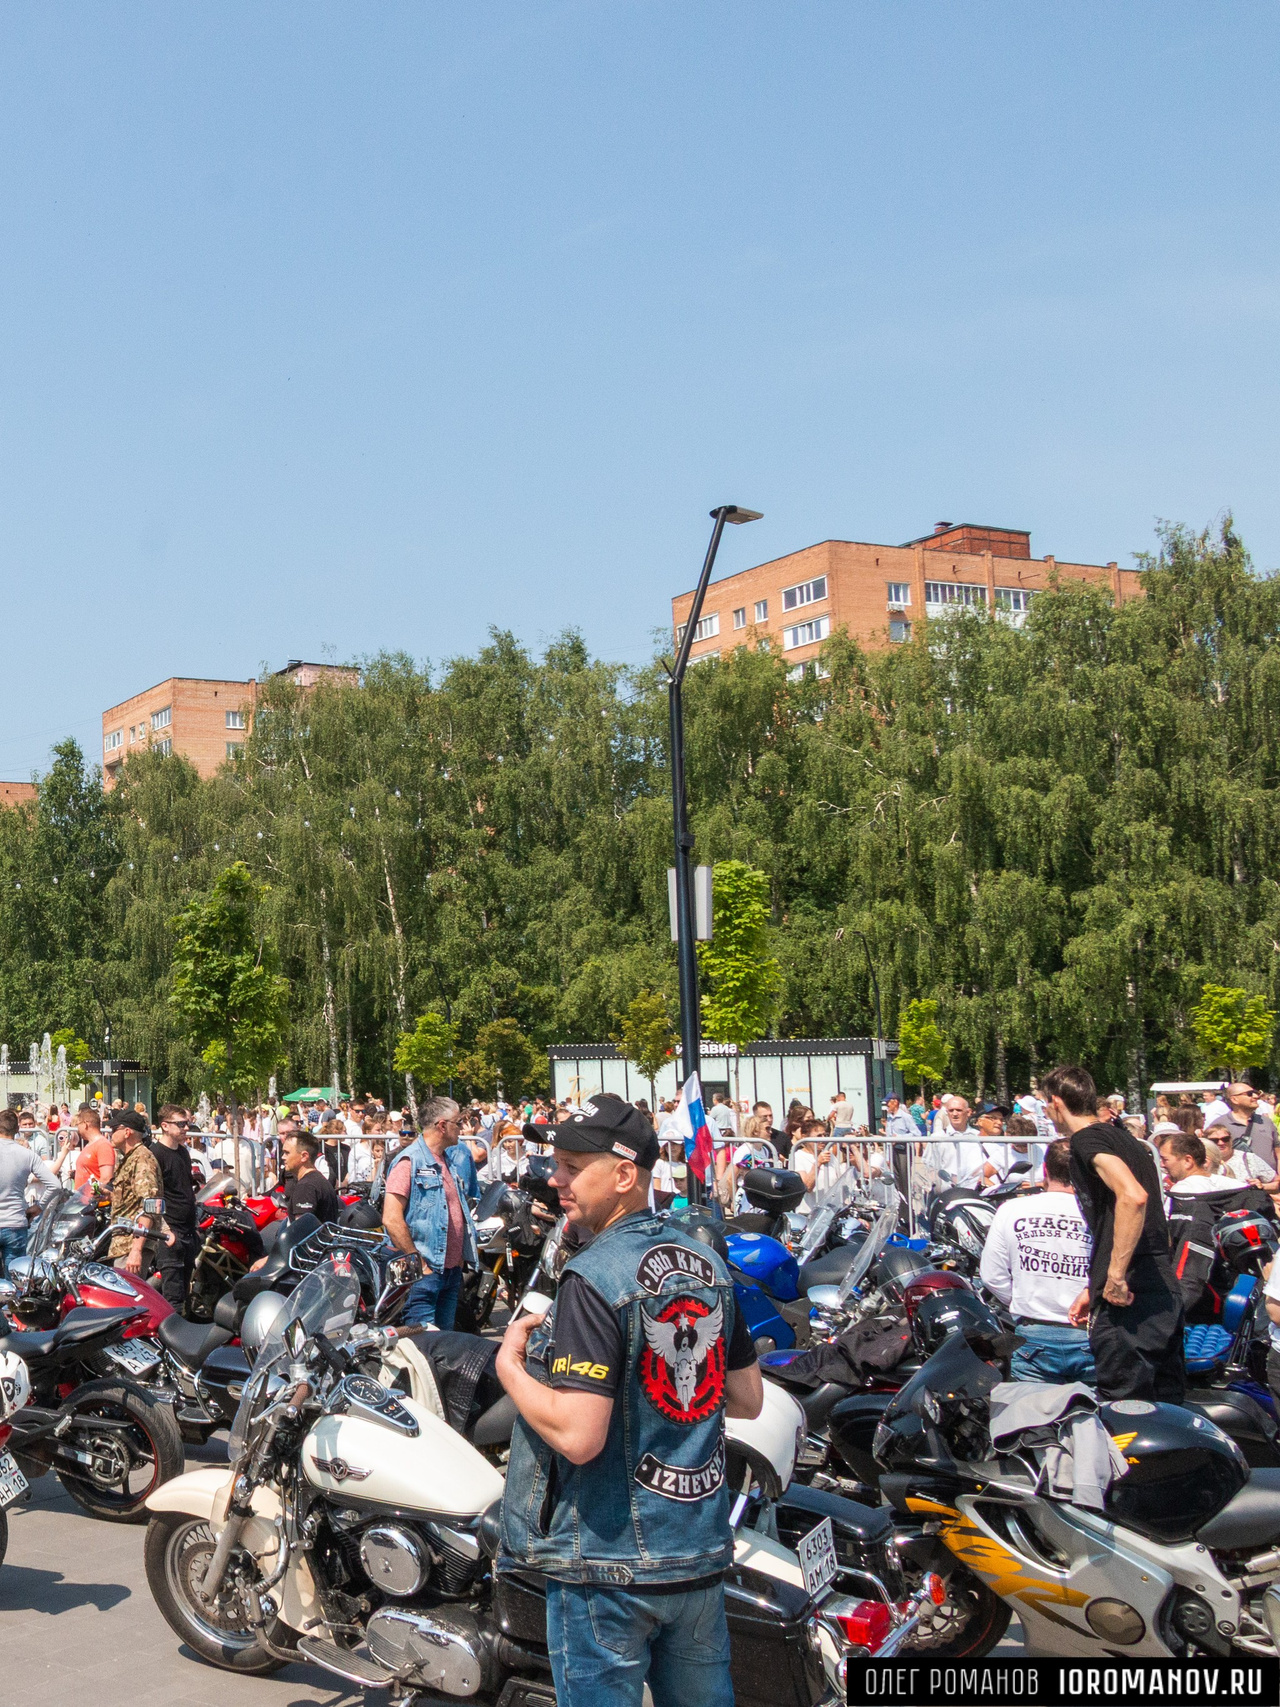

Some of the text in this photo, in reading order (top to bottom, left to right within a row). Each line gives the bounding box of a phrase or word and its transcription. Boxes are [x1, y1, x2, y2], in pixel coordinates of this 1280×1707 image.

[675, 1043, 737, 1054] иавиа
[1013, 1217, 1083, 1233] СЧАСТ
[1015, 1229, 1093, 1245] НЕЛЬЗЯ КУП
[1017, 1241, 1090, 1265] МОЖНО КУП
[643, 1250, 704, 1283] 18th KM
[1019, 1254, 1089, 1278] МОТОЦИК
[12, 1474, 26, 1490] 18
[806, 1527, 829, 1560] 6303
[824, 1553, 836, 1575] 18
